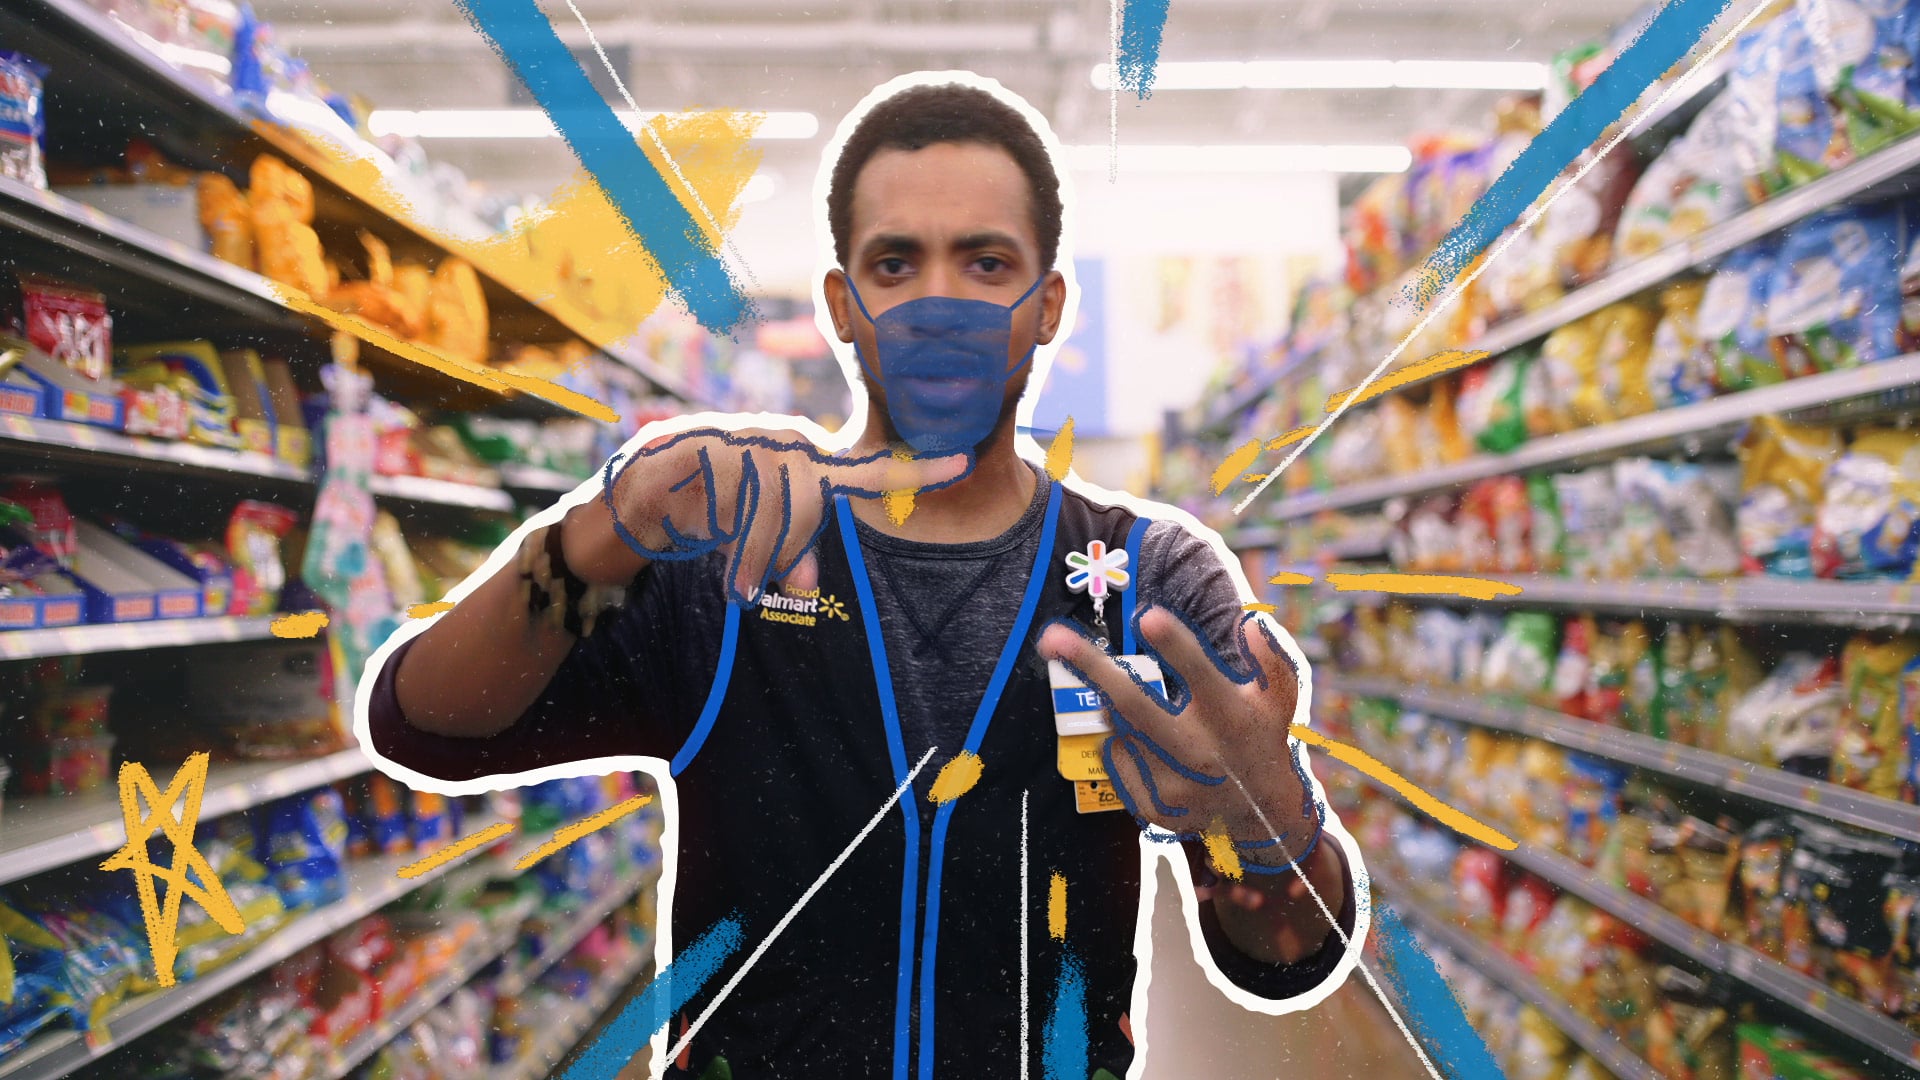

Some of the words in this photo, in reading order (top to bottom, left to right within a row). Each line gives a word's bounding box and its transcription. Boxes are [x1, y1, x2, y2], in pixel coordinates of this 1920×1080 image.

[747, 585, 818, 613] Walmart
[785, 584, 820, 599] Proud
[760, 607, 816, 626] Associate
